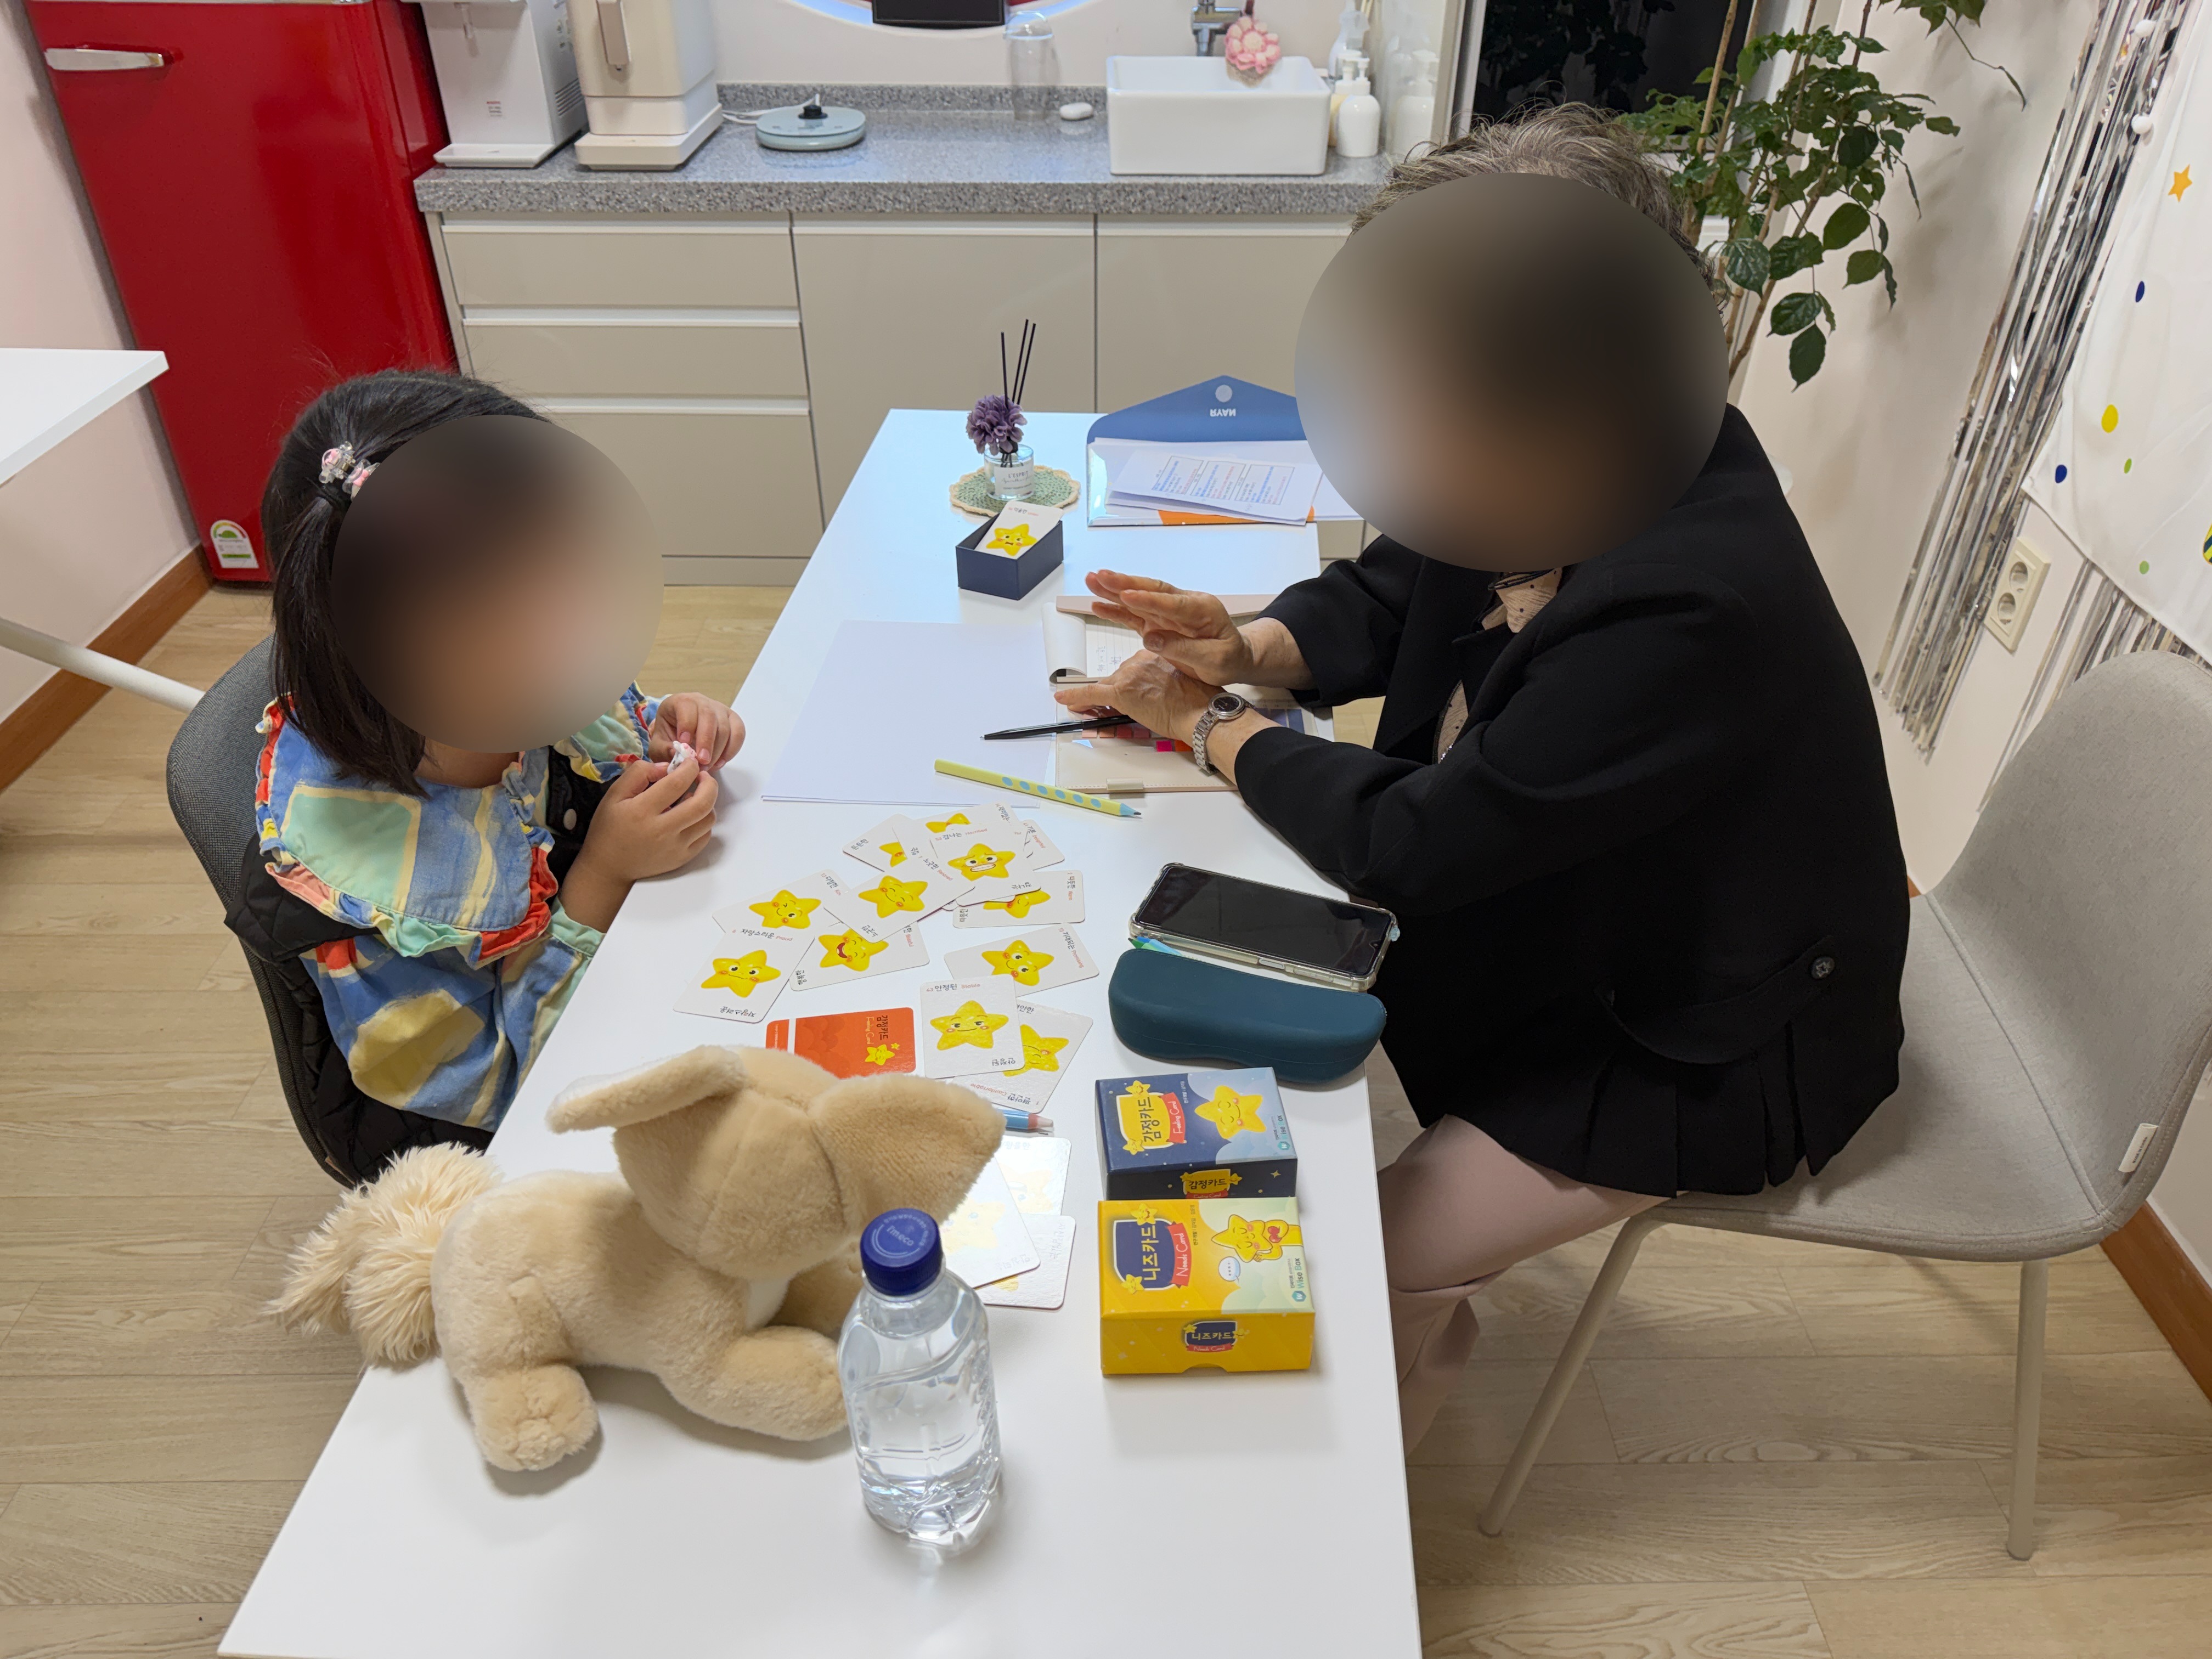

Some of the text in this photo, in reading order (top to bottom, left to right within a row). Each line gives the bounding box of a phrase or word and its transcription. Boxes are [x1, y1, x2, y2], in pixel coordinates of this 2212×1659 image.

[826, 876, 838, 888] 다정한
[741, 929, 775, 939] 자랑스러운
[934, 984, 957, 992] 안정된
[720, 1006, 756, 1017] 자랑스러운
[877, 1015, 888, 1041] 감정카드
[992, 1057, 1015, 1066] 안정된
[1007, 1093, 1031, 1104] 편안한
[1167, 1101, 1180, 1115] Card
[1137, 1097, 1161, 1142] 감정카드
[1189, 1178, 1227, 1190] 감정카드
[1141, 1225, 1161, 1280] 니즈카드
[1173, 1233, 1189, 1277] Needs Card
[1296, 1272, 1305, 1289] Wise
[1192, 1331, 1232, 1340] 니즈카드
